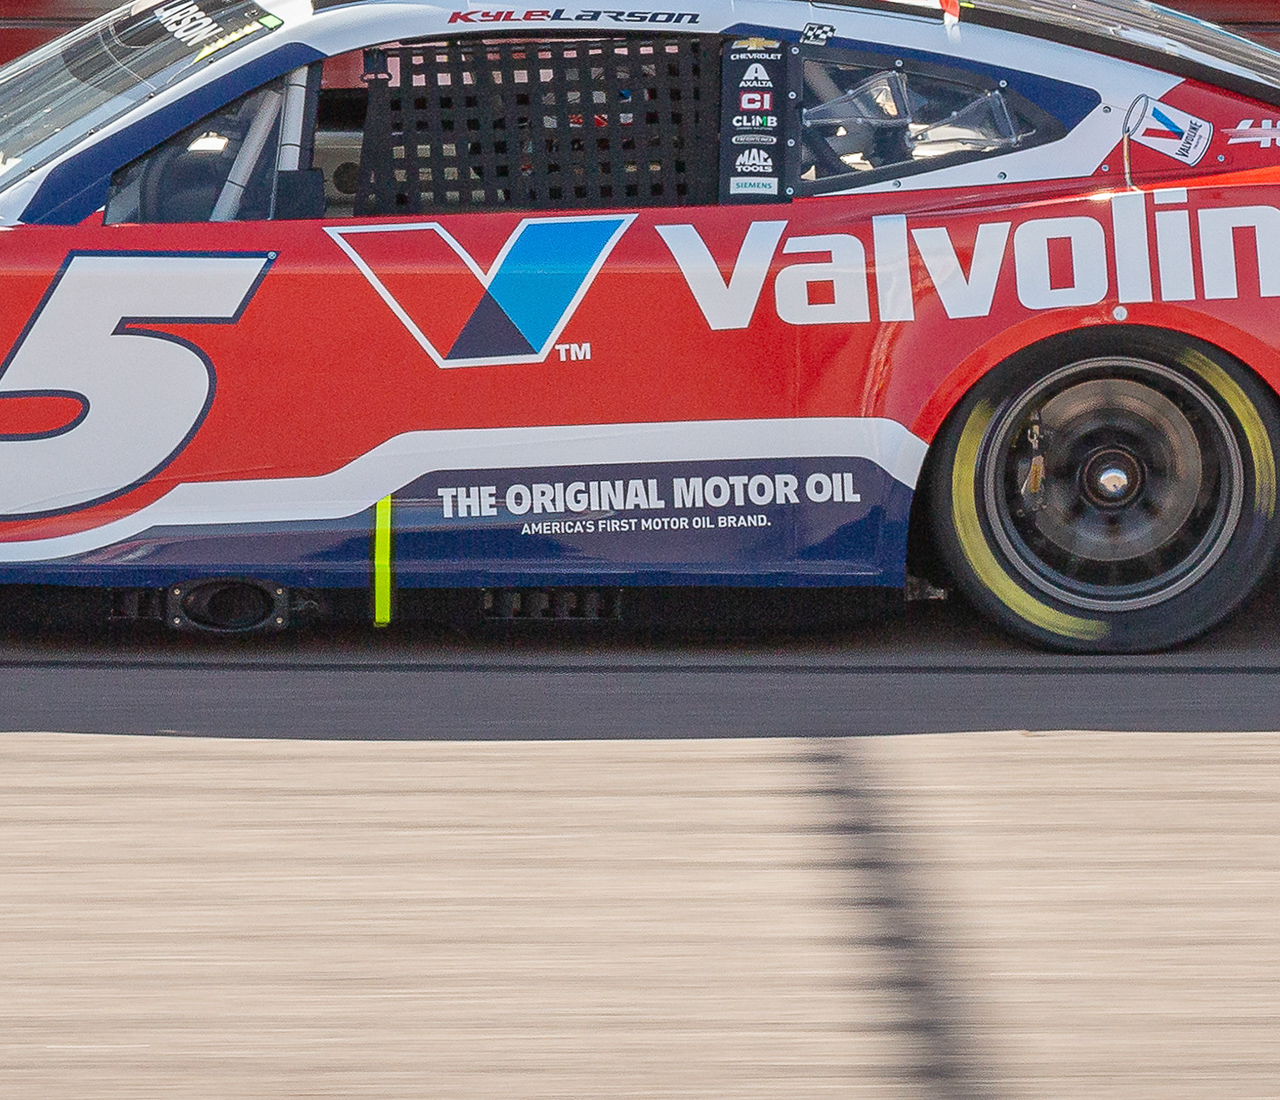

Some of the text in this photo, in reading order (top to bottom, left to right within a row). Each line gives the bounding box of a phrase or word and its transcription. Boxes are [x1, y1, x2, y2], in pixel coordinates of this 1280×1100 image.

[730, 52, 782, 60] CHEVROLET
[738, 80, 774, 88] AXALTA
[741, 92, 771, 110] CI
[1174, 119, 1203, 158] VALVOLINE
[735, 147, 773, 166] MAC
[735, 164, 773, 173] TOOLS
[735, 181, 773, 190] SIEMENS
[554, 342, 592, 362] TM
[436, 472, 862, 519] THE ORIGINAL MOTOR OIL
[521, 514, 772, 535] AMERICA'S FIRST MOTOR OIL BRAND.
